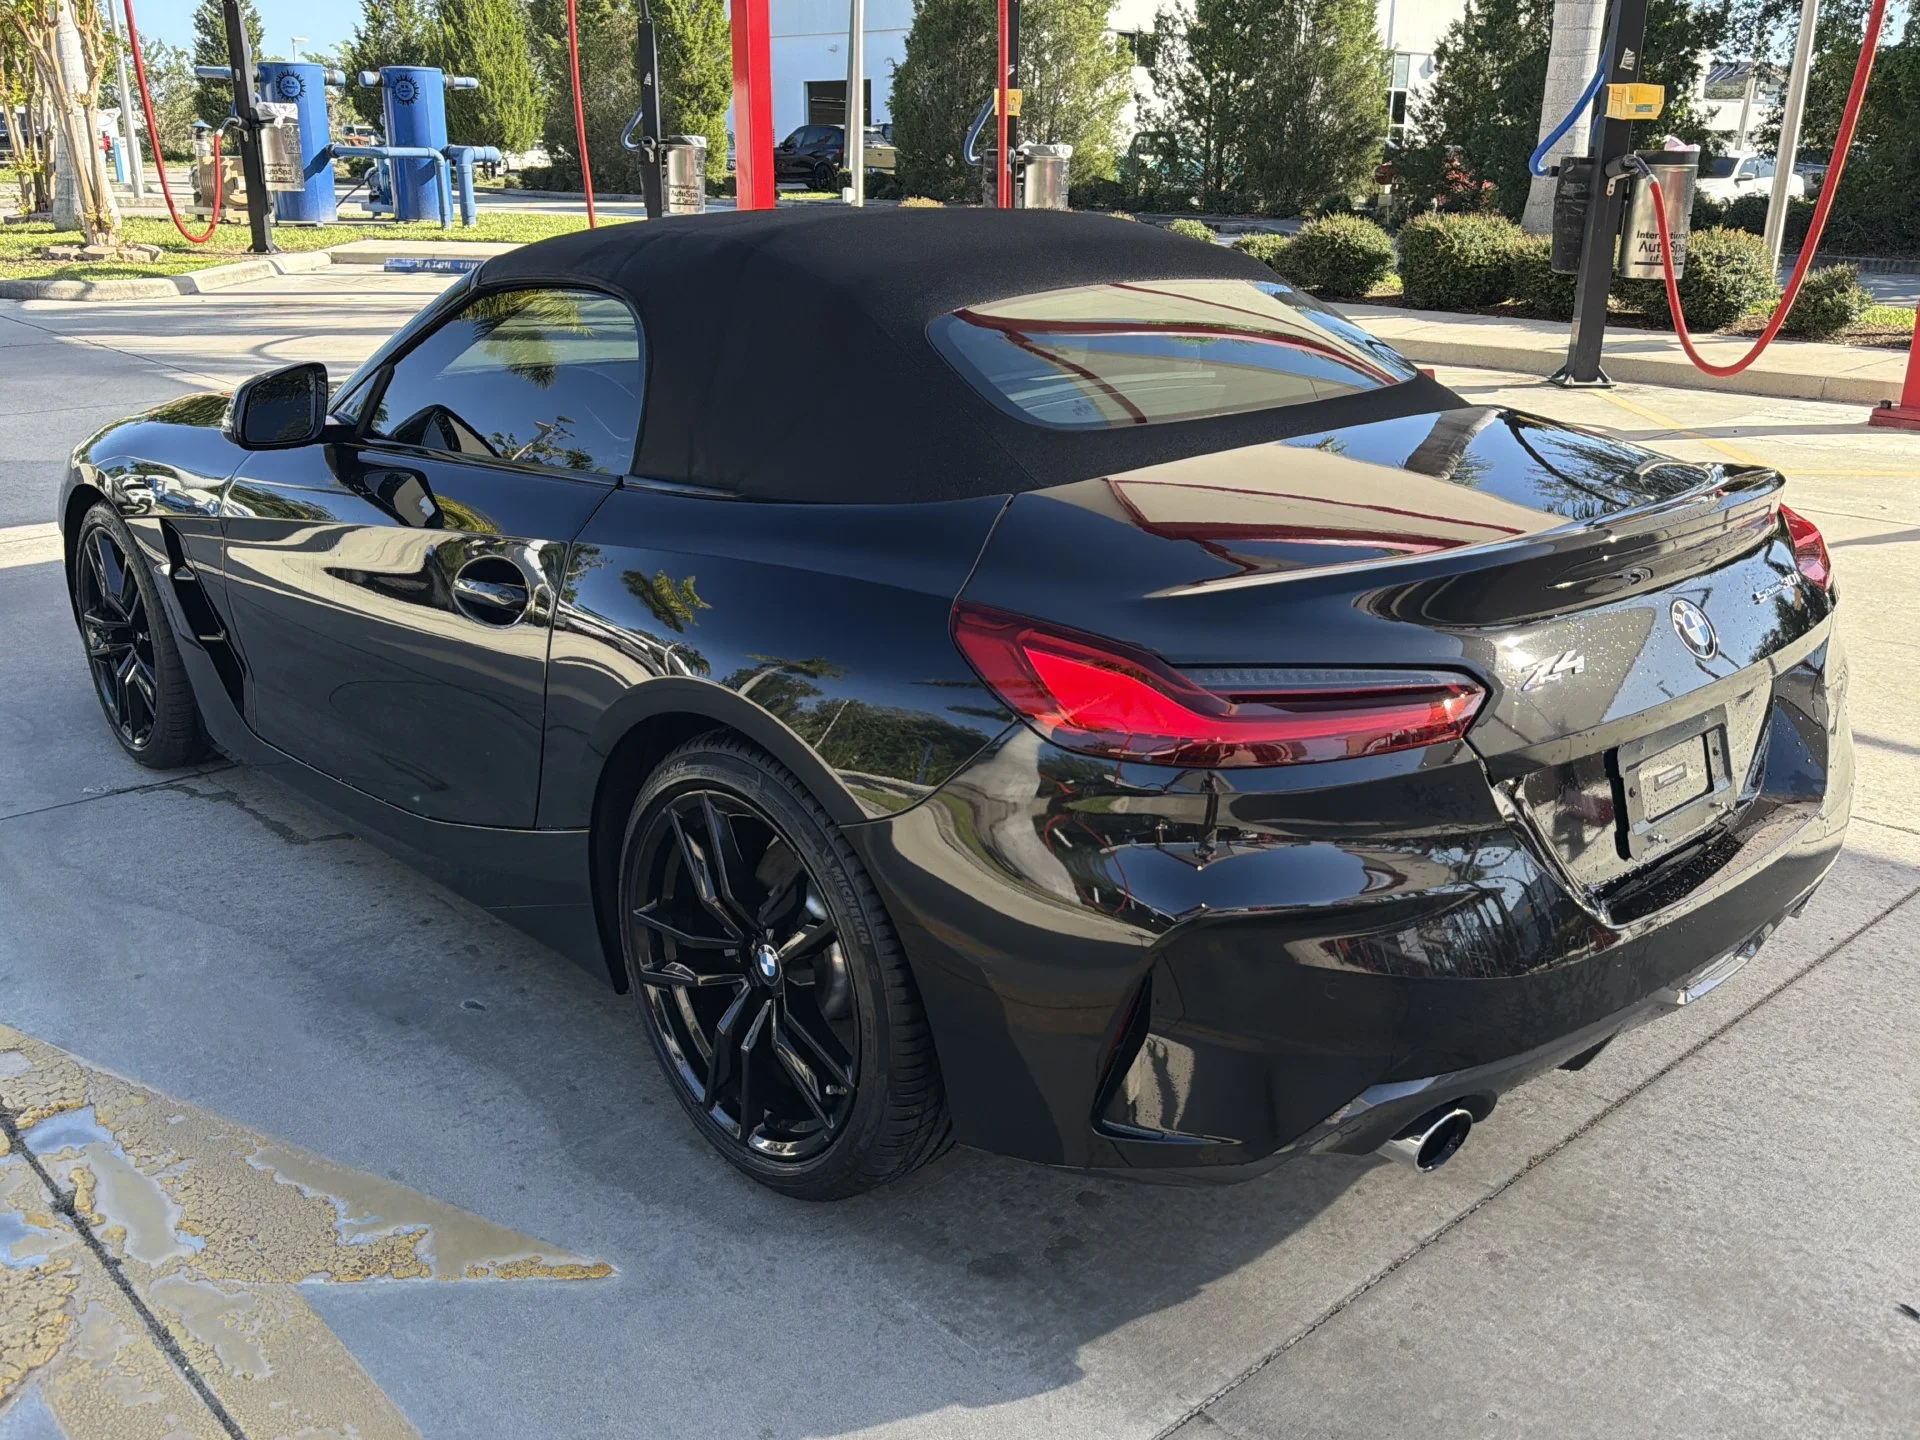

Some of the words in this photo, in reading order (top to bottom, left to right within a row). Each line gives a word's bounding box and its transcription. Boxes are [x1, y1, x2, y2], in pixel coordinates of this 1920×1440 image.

[1636, 229, 1688, 240] Intertional
[1638, 241, 1685, 255] AutSpa
[1519, 649, 1585, 692] Z4
[830, 866, 871, 945] MICHELIN
